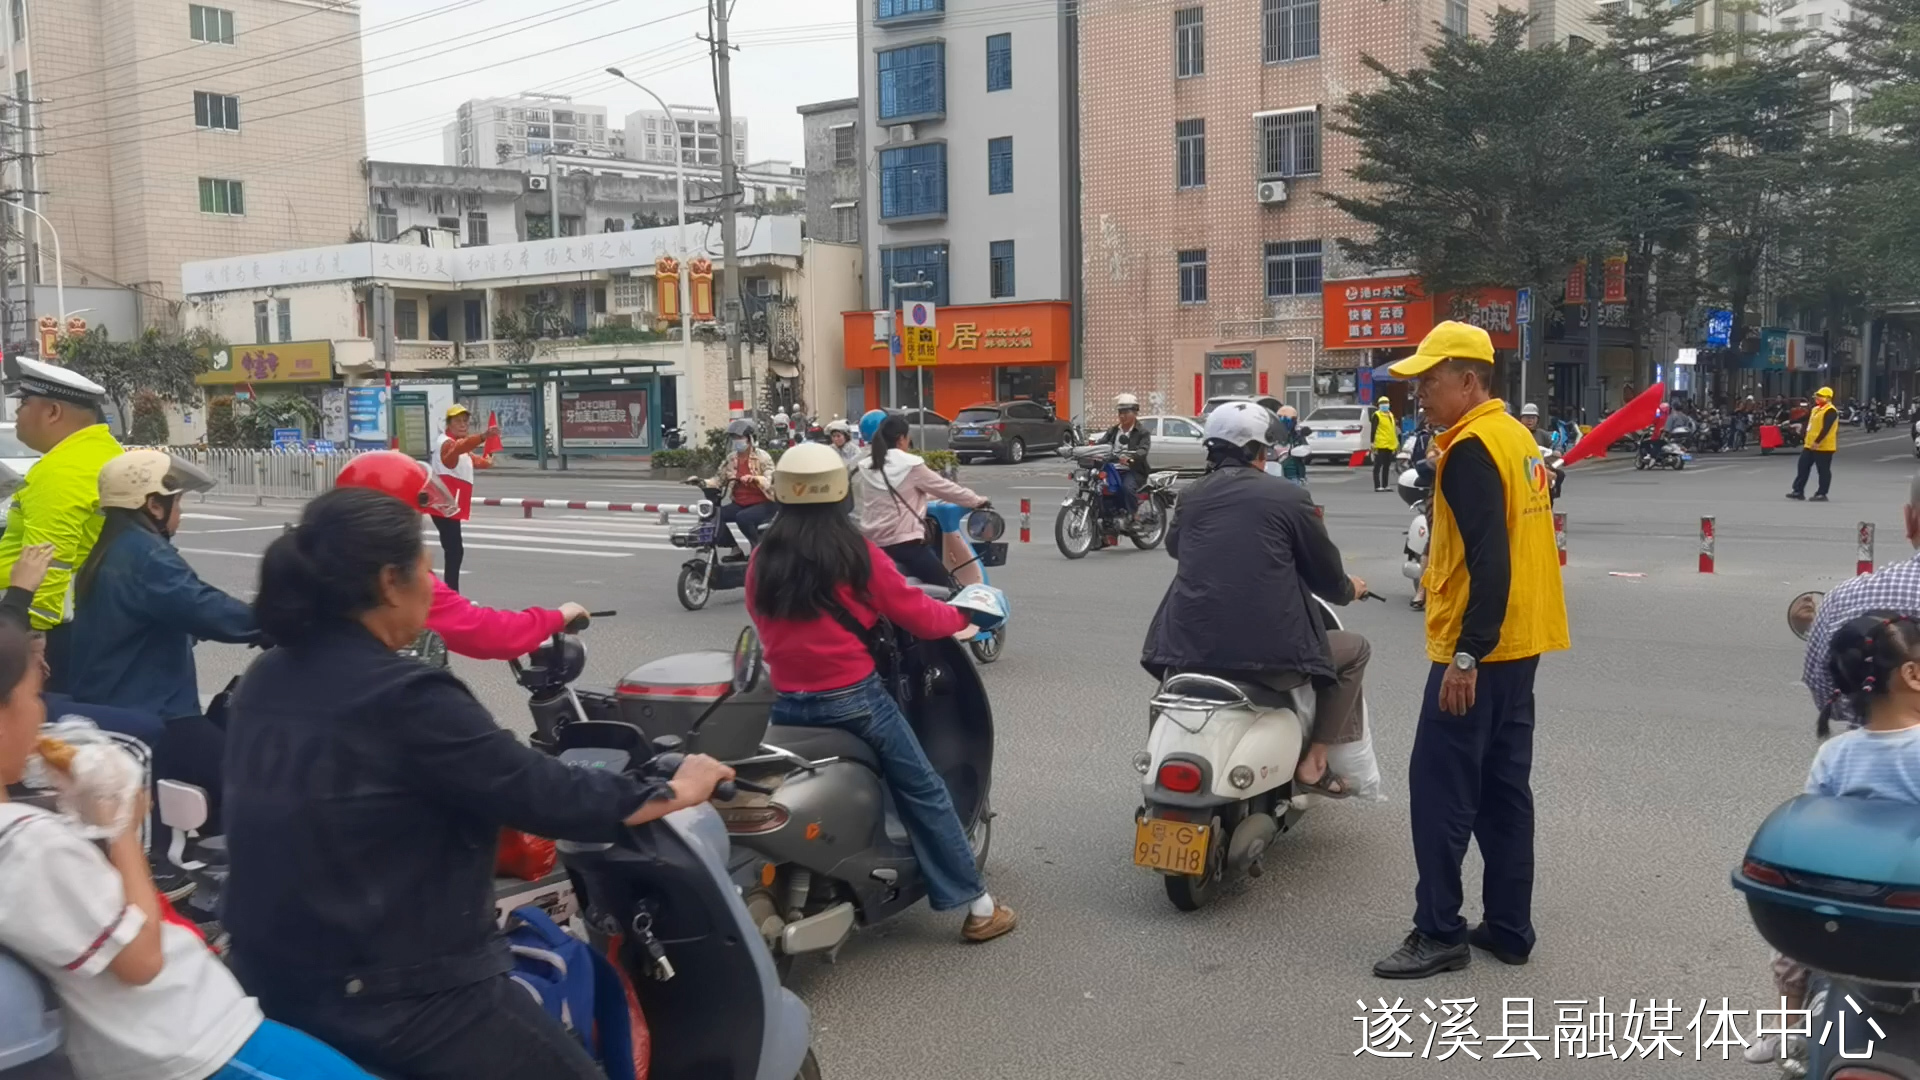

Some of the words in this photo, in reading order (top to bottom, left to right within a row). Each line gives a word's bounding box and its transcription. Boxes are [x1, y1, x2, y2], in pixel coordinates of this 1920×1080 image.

[1348, 308, 1372, 321] 快餐
[1348, 324, 1373, 338] 面食
[1138, 841, 1201, 871] 951H8
